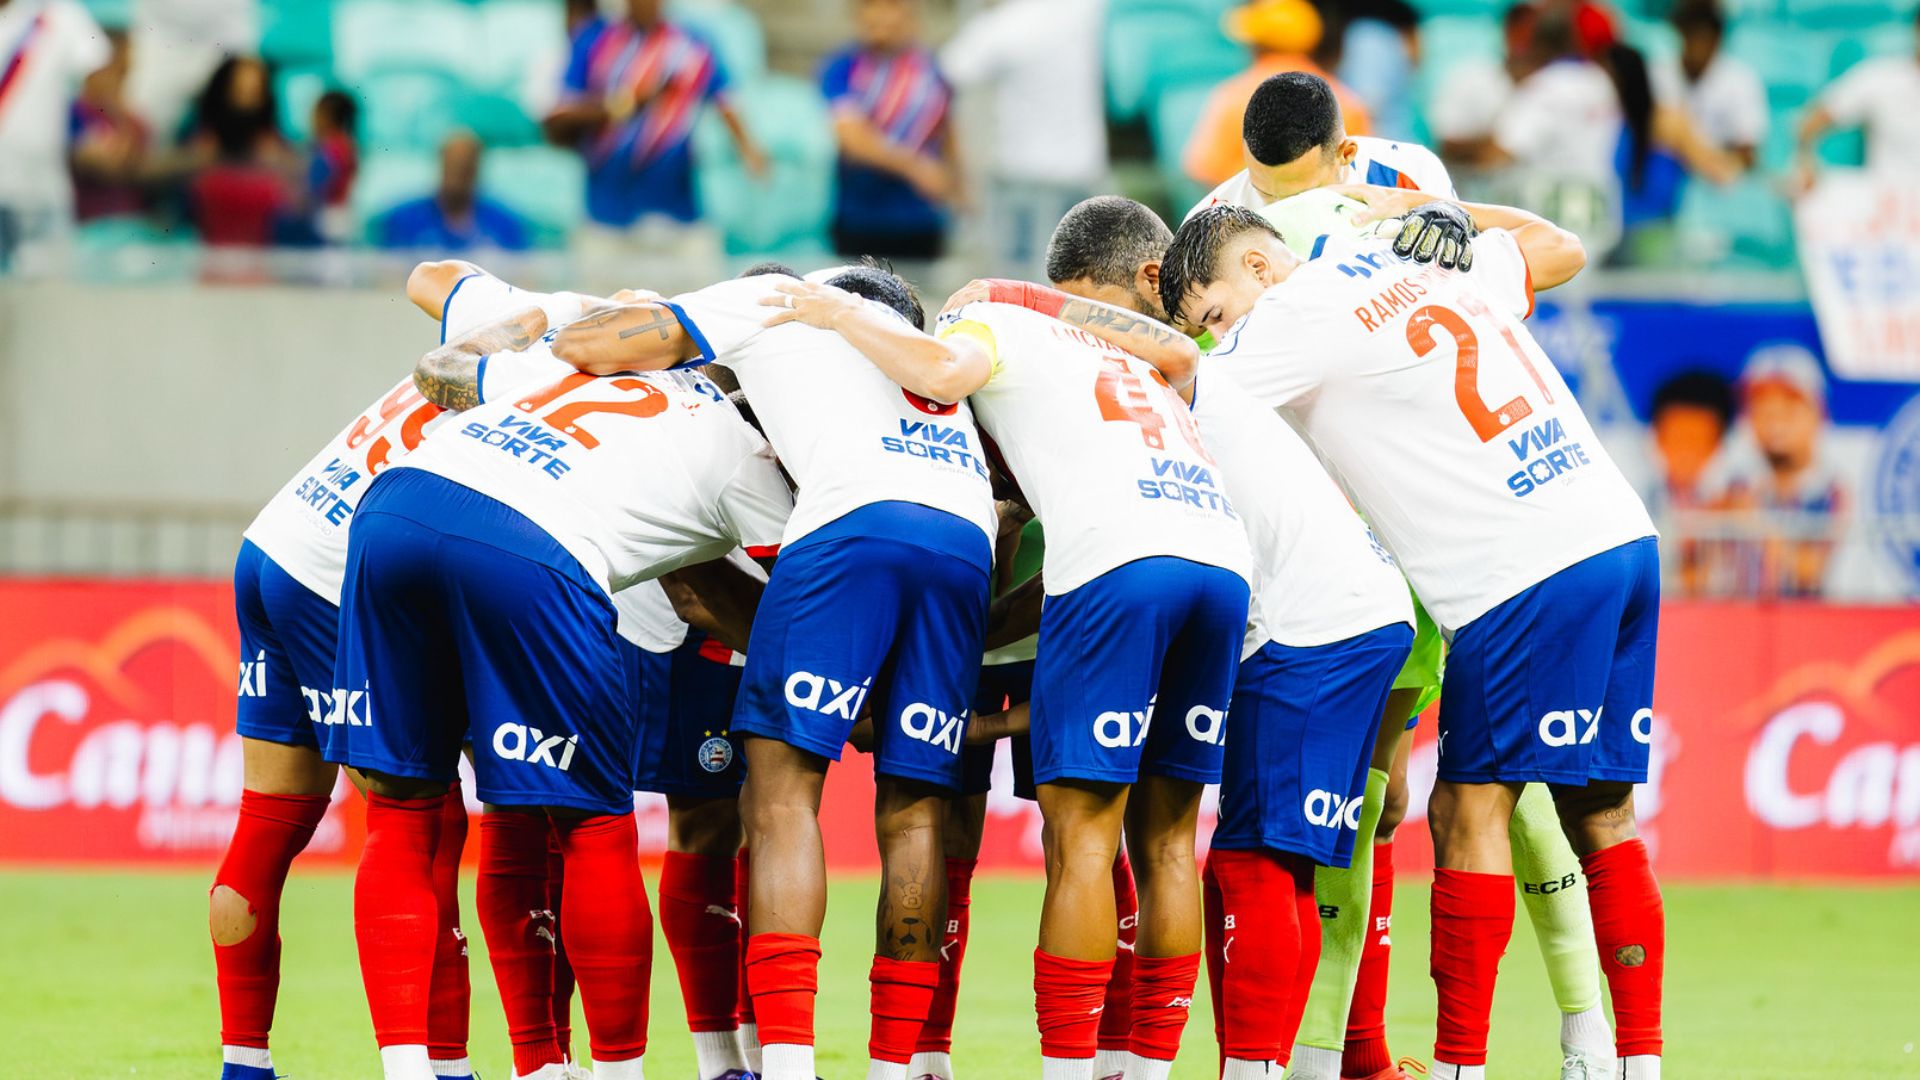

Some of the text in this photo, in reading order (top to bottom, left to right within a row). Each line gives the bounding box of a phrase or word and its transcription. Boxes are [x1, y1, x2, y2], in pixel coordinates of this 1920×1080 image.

[1354, 278, 1427, 332] RAMOS
[461, 422, 571, 481] SORTE
[498, 414, 568, 452] VIVA
[900, 418, 968, 449] VIVA
[1508, 417, 1567, 461] VIVA
[322, 457, 361, 491] VIVA
[881, 436, 988, 482] SORTE
[1151, 457, 1215, 488] VIVA
[1507, 443, 1591, 497] SORTE
[295, 476, 354, 526] SORTE
[1138, 479, 1238, 521] SORTE
[239, 649, 267, 697] xi
[784, 671, 872, 721] axi
[493, 722, 579, 771] axi
[900, 702, 968, 755] axi
[1539, 705, 1604, 747] ax
[1304, 788, 1348, 831] ax
[1524, 873, 1576, 895] ECB
